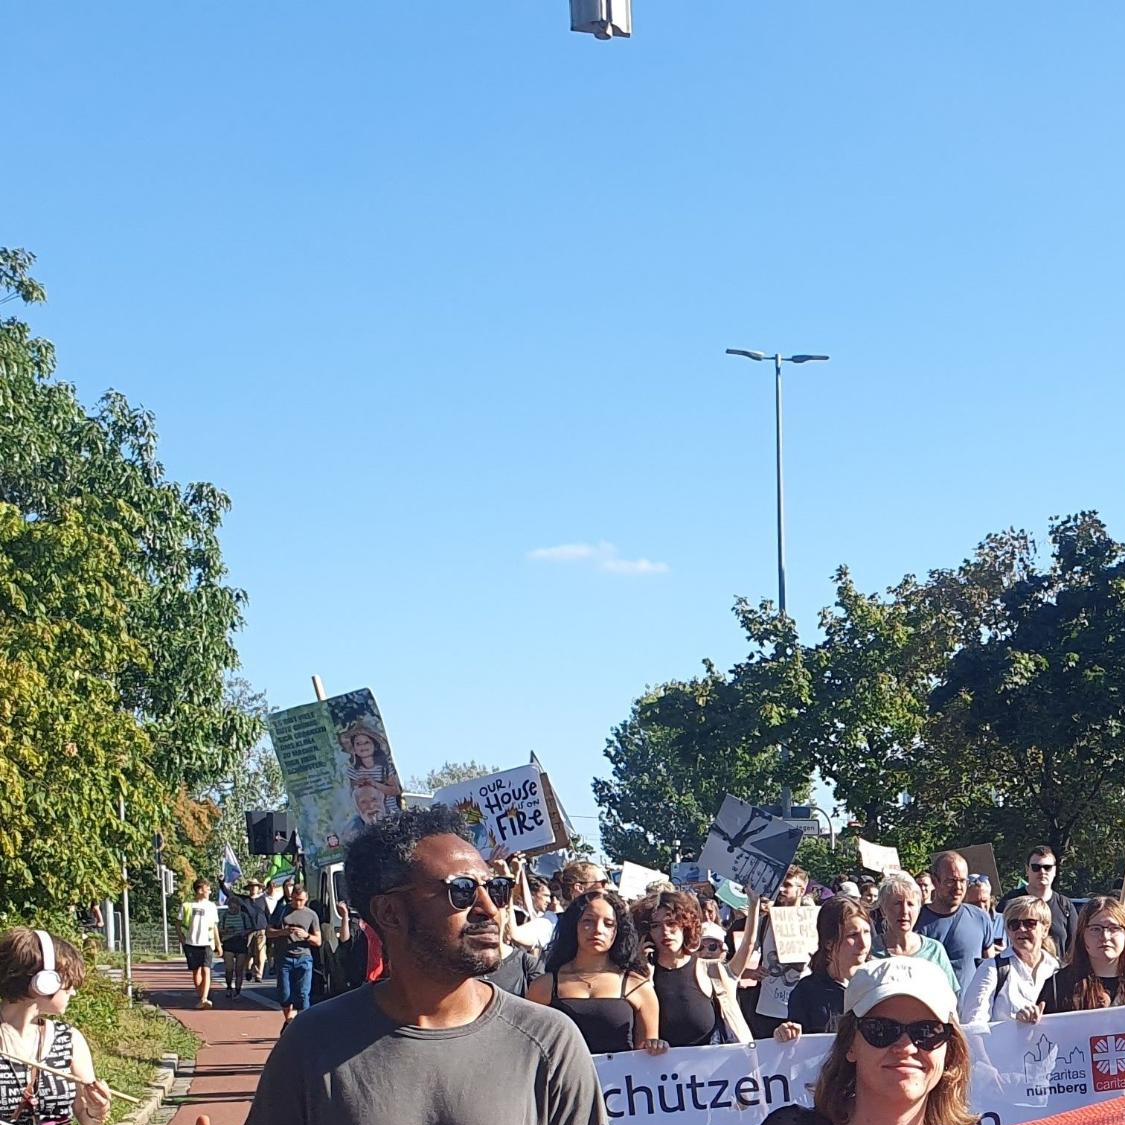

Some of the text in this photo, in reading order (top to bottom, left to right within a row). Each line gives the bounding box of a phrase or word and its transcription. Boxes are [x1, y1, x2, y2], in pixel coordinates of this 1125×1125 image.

[479, 778, 506, 797] OUR
[484, 779, 538, 814] HOUSE
[526, 798, 540, 808] ON
[496, 808, 545, 841] FIRE
[1046, 1068, 1086, 1081] caritas
[604, 1071, 791, 1118] chützen
[1026, 1083, 1088, 1096] nürnberg
